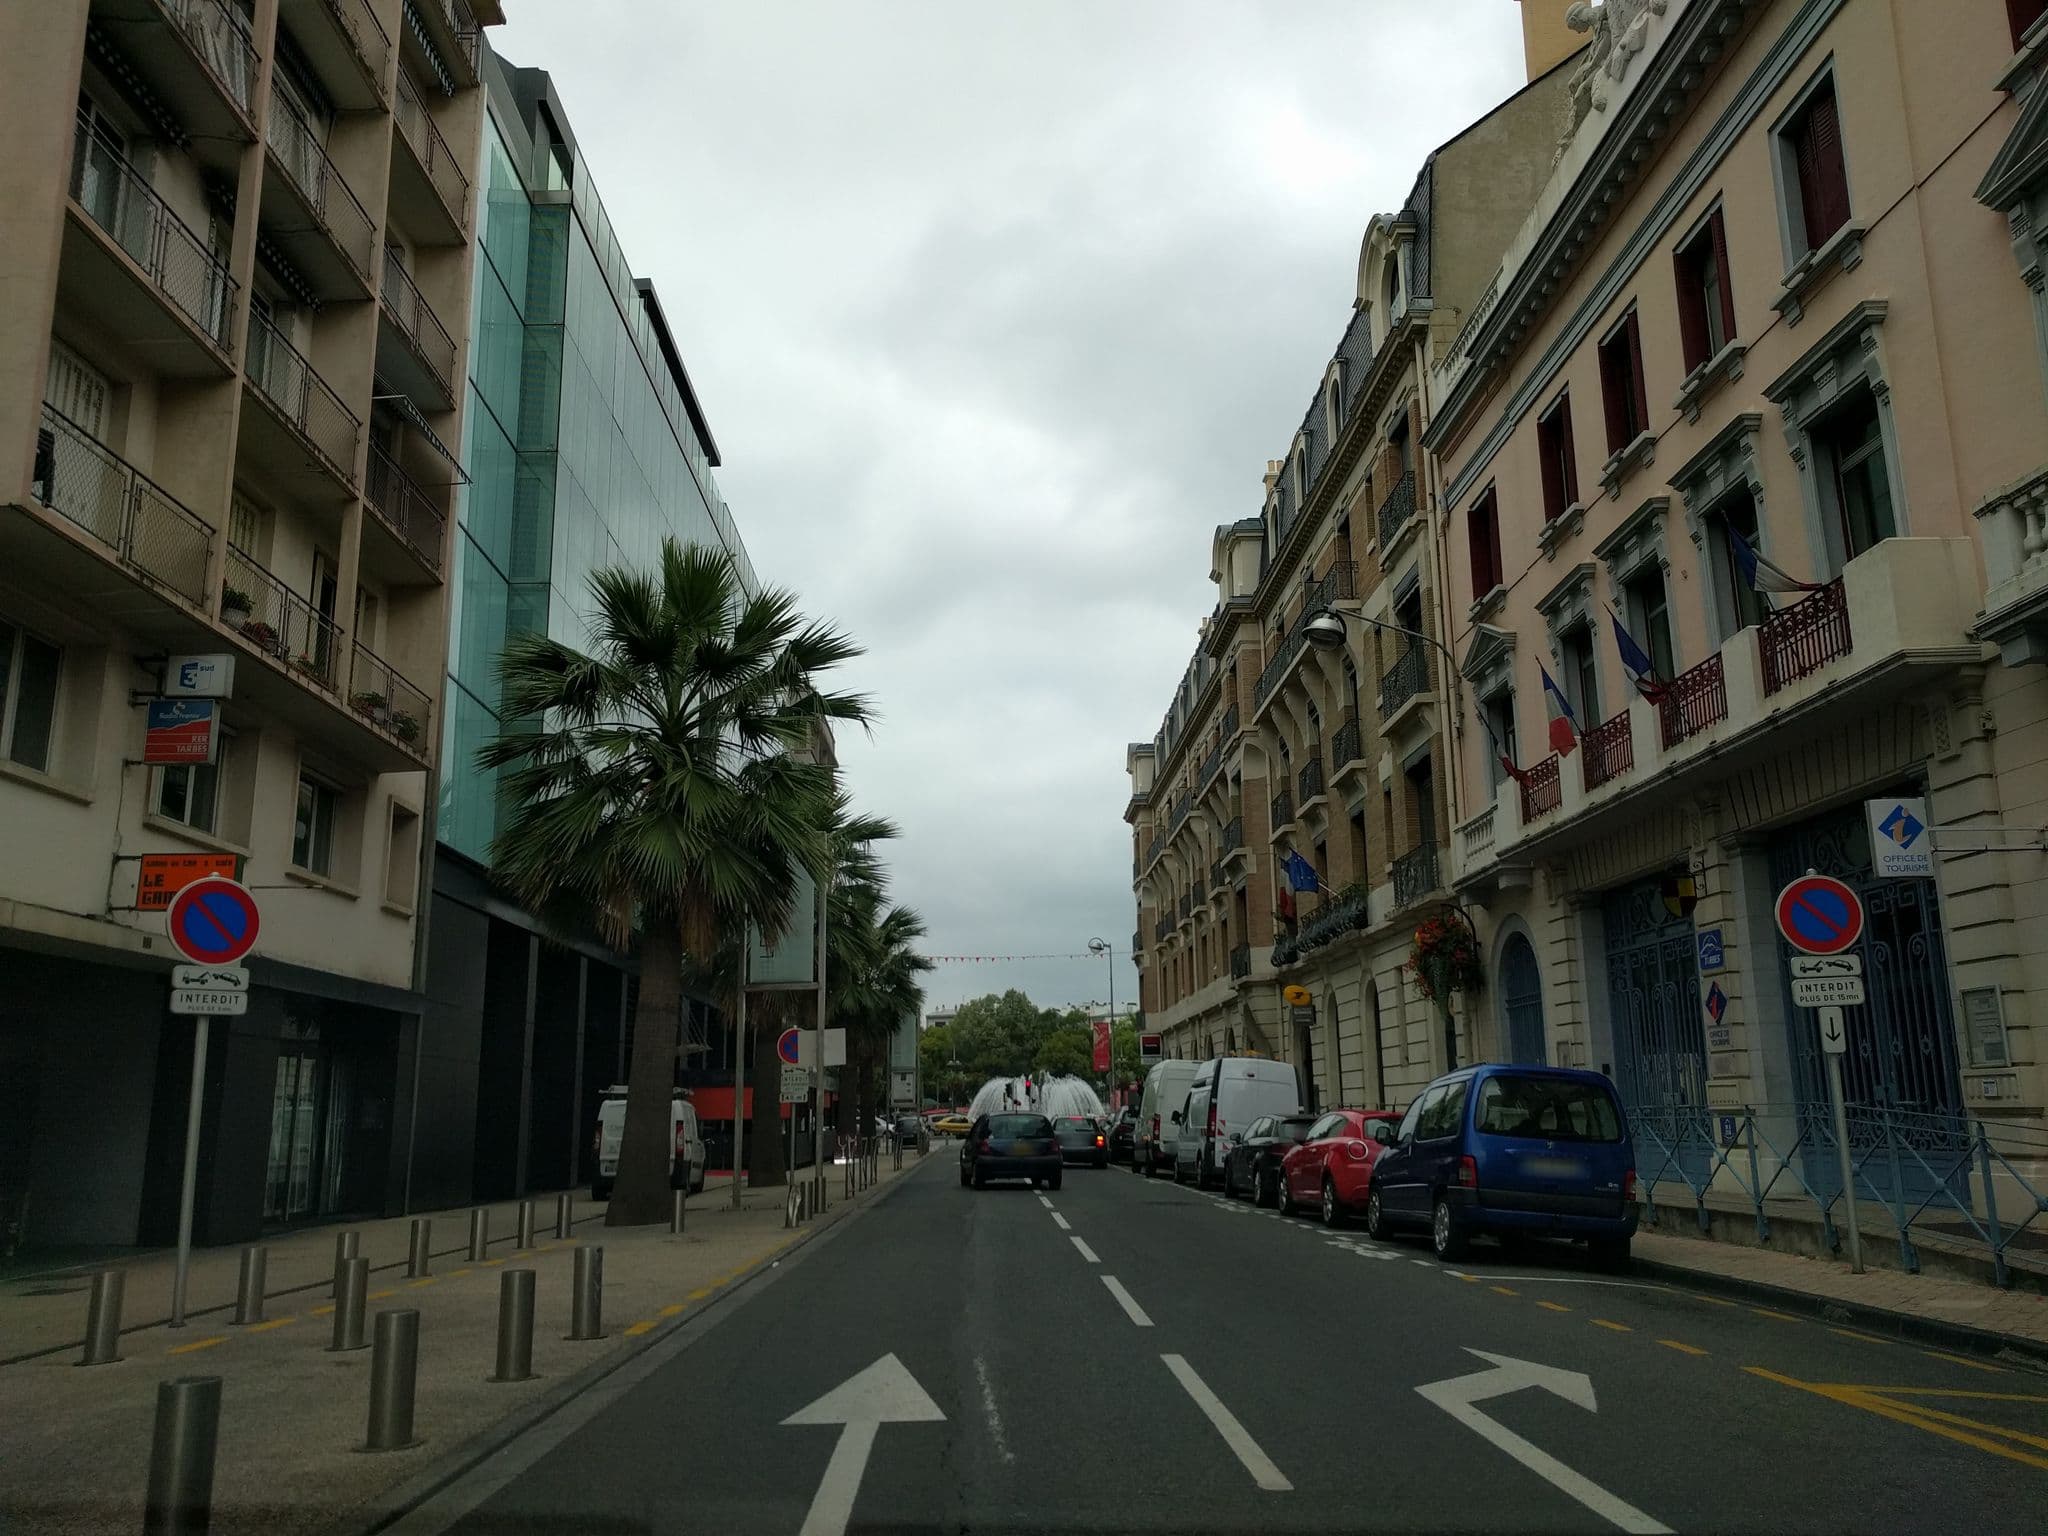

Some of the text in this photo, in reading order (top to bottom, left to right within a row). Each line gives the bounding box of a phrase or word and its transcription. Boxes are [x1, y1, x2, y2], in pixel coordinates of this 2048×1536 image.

[1882, 854, 1929, 863] OFFICE DE
[1887, 864, 1929, 873] TOURISME
[144, 874, 164, 887] LE
[1799, 981, 1855, 993] INTERDIT
[180, 994, 240, 1005] INTERDIT
[1799, 993, 1860, 1003] PLUS DE 15mn
